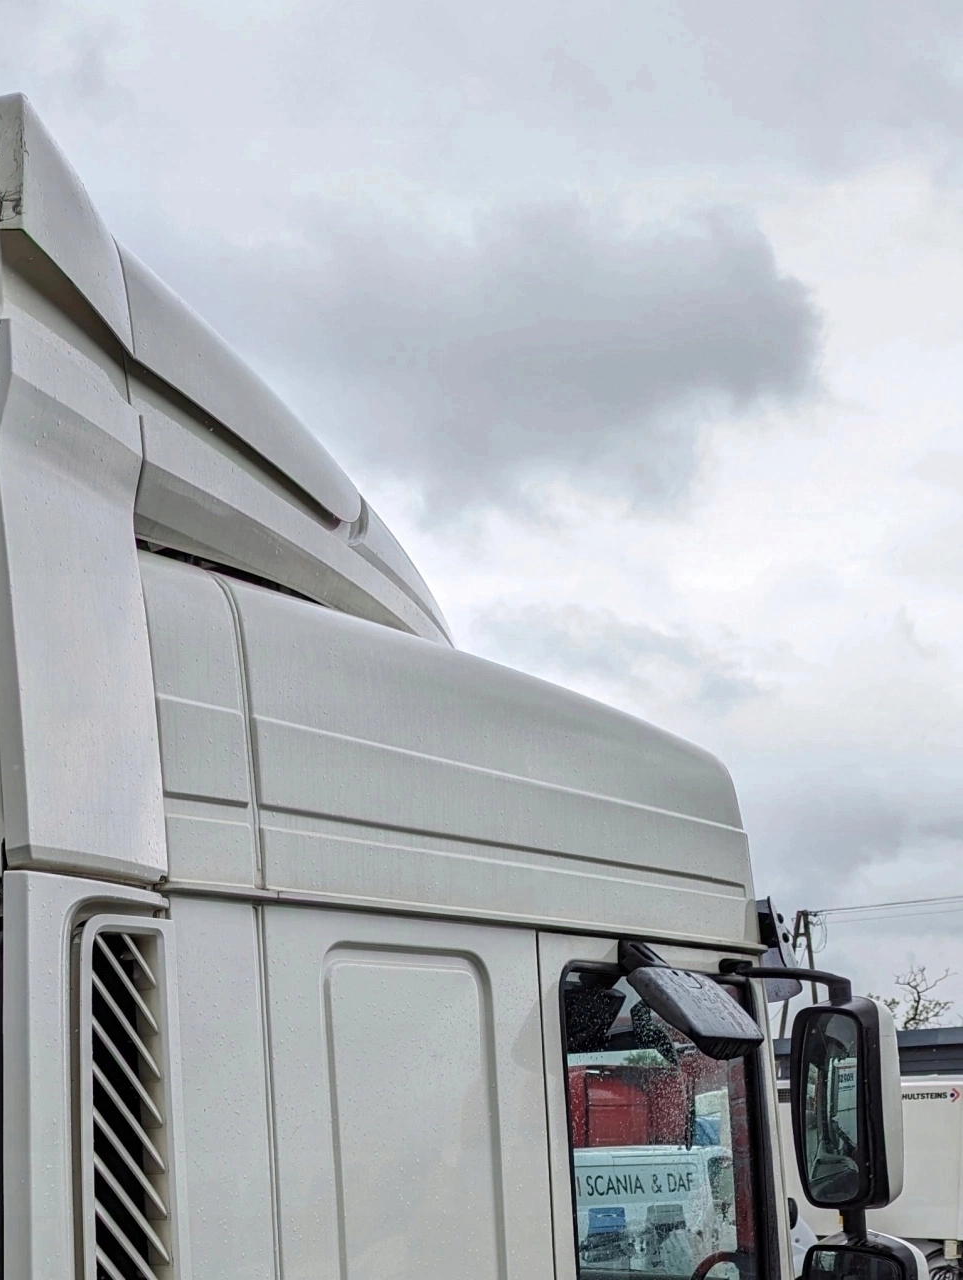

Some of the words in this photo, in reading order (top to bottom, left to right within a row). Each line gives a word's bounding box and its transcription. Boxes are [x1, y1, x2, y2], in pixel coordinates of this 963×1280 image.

[586, 1174, 645, 1197] SCANIA
[651, 1173, 662, 1194] &
[667, 1172, 693, 1193] DAF
